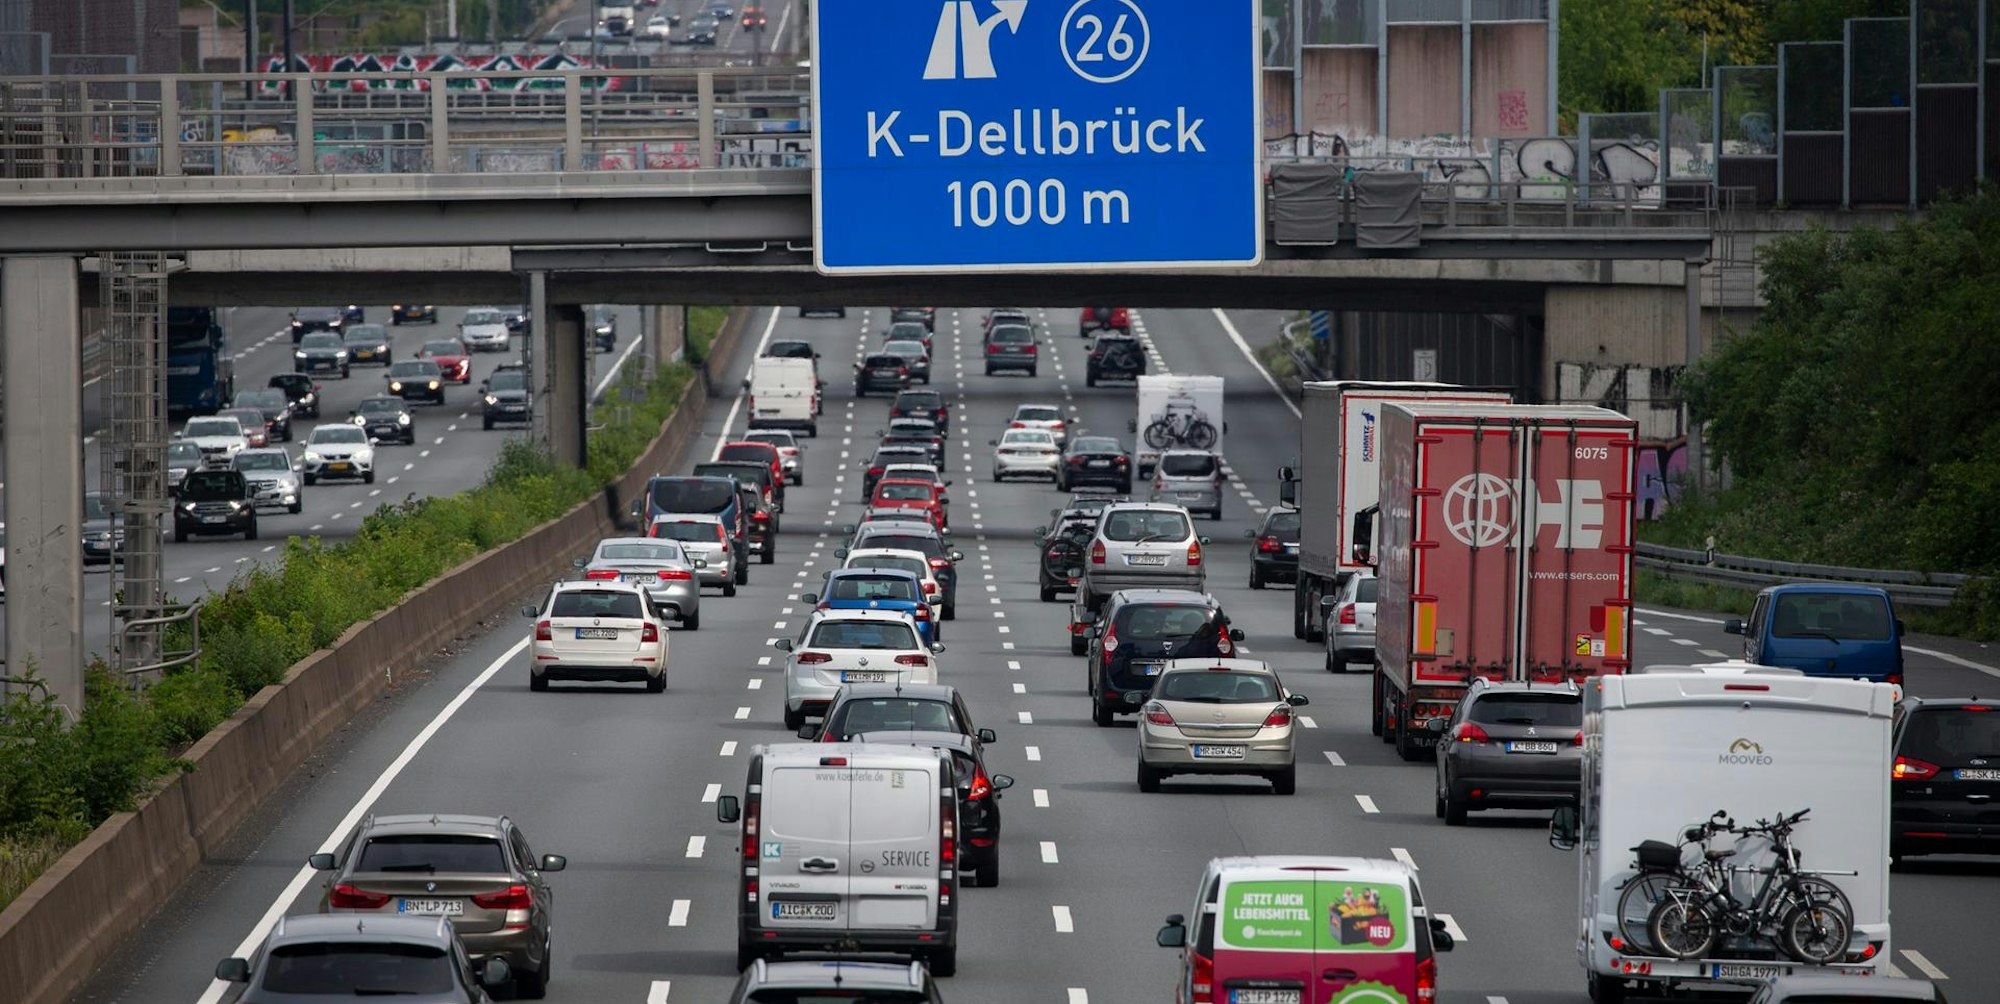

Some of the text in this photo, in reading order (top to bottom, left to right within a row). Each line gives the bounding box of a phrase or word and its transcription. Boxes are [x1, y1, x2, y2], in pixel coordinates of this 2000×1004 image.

[1075, 14, 1134, 62] 26
[867, 106, 1206, 157] K-Dellbrück
[946, 178, 1130, 228] 1000 m
[1575, 447, 1608, 460] 6075
[1719, 754, 1773, 765] MOOVEO
[1976, 770, 1988, 779] SK
[764, 843, 780, 857] K
[882, 850, 930, 867] SERVICE
[1241, 893, 1304, 906] JETZT AUCH
[405, 901, 462, 912] BN LP 713
[781, 904, 800, 915] AIC
[814, 905, 834, 916] 200
[1233, 908, 1312, 920] LEBENSMITTEL
[1370, 926, 1391, 938] NEU
[1721, 966, 1777, 978] SU GA 1977
[1237, 990, 1299, 1002] MS FP 1273
